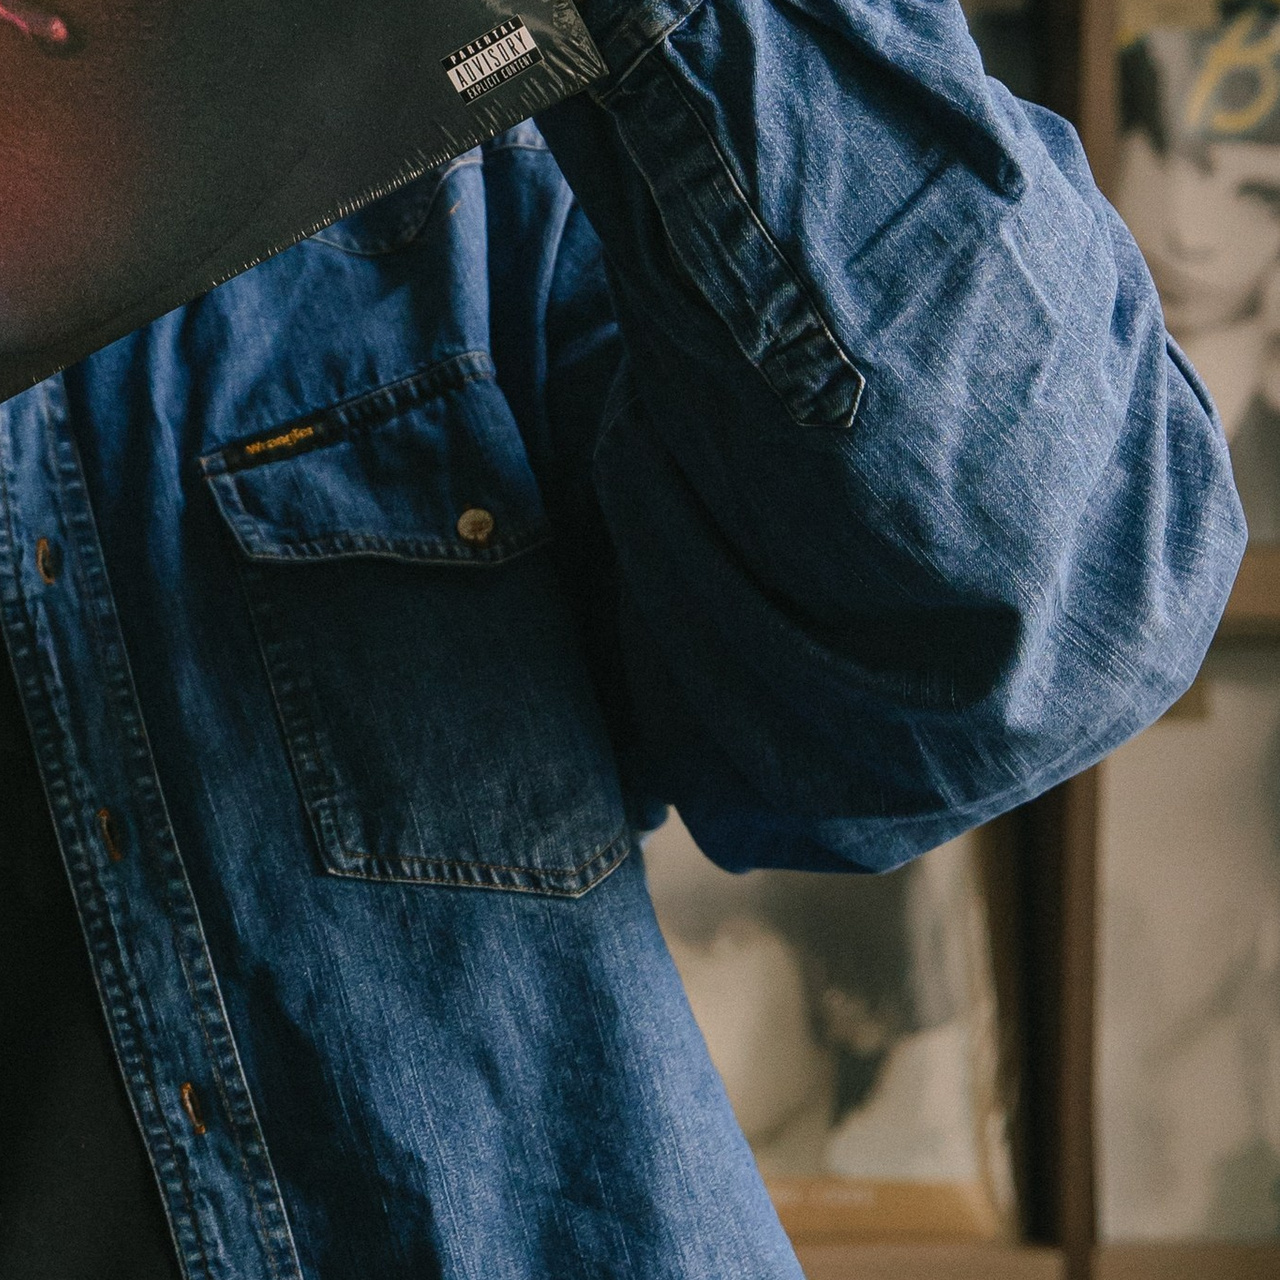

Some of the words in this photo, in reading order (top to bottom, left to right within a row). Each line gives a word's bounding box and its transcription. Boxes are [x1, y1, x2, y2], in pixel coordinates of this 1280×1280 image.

[450, 21, 516, 65] PARENTAL
[455, 31, 528, 88] ADVISORY
[466, 73, 500, 99] EXPLICIT
[501, 53, 534, 79] CONTENT
